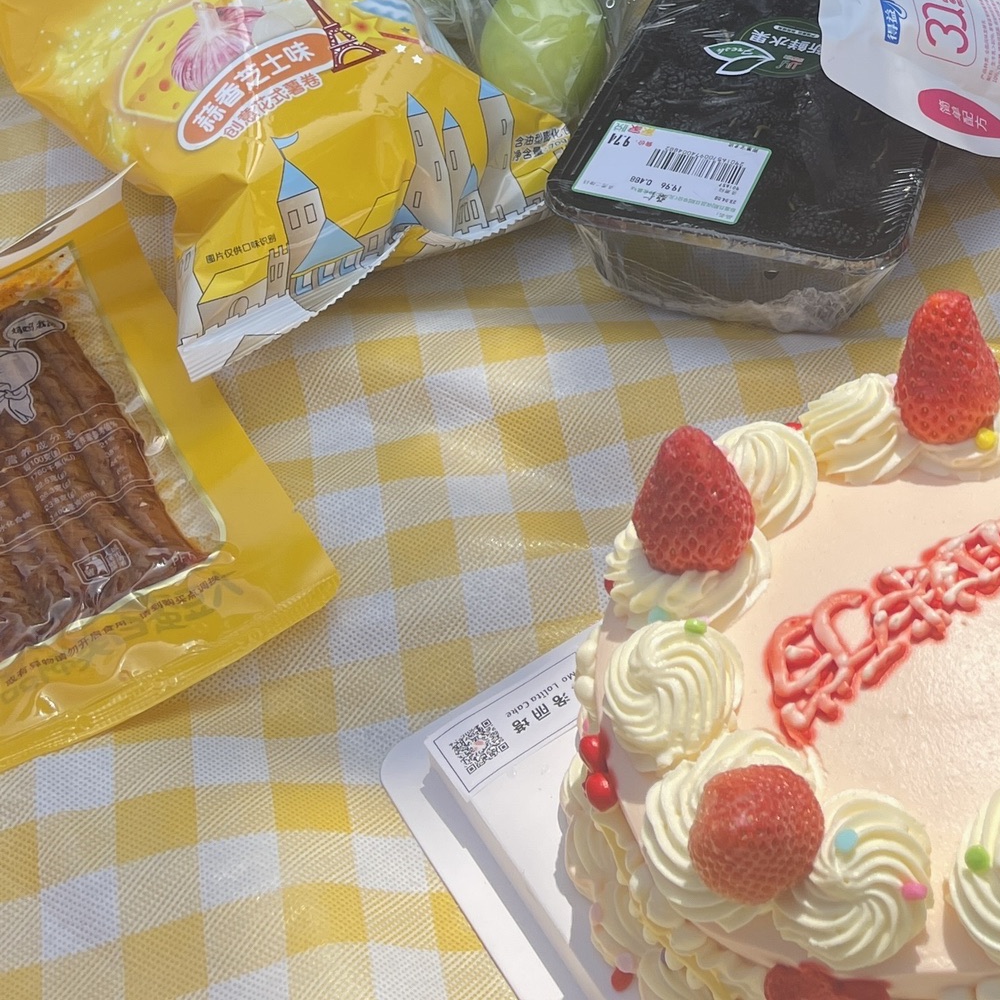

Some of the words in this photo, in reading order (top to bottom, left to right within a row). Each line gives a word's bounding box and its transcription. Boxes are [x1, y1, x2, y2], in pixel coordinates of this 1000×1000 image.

[884, 3, 901, 42] 得益
[715, 43, 755, 56] Fresh
[192, 41, 315, 132] 蒜香芝士味
[223, 73, 322, 139] 创意花式薯卷
[938, 99, 988, 132] 简单配方
[607, 133, 632, 148] 9.74
[660, 182, 682, 192] 19.96
[205, 233, 277, 264] 图片仅供口味识别
[5, 428, 77, 466] 营养成分表
[505, 701, 531, 718] Cake
[511, 692, 571, 735] 洛丽塔
